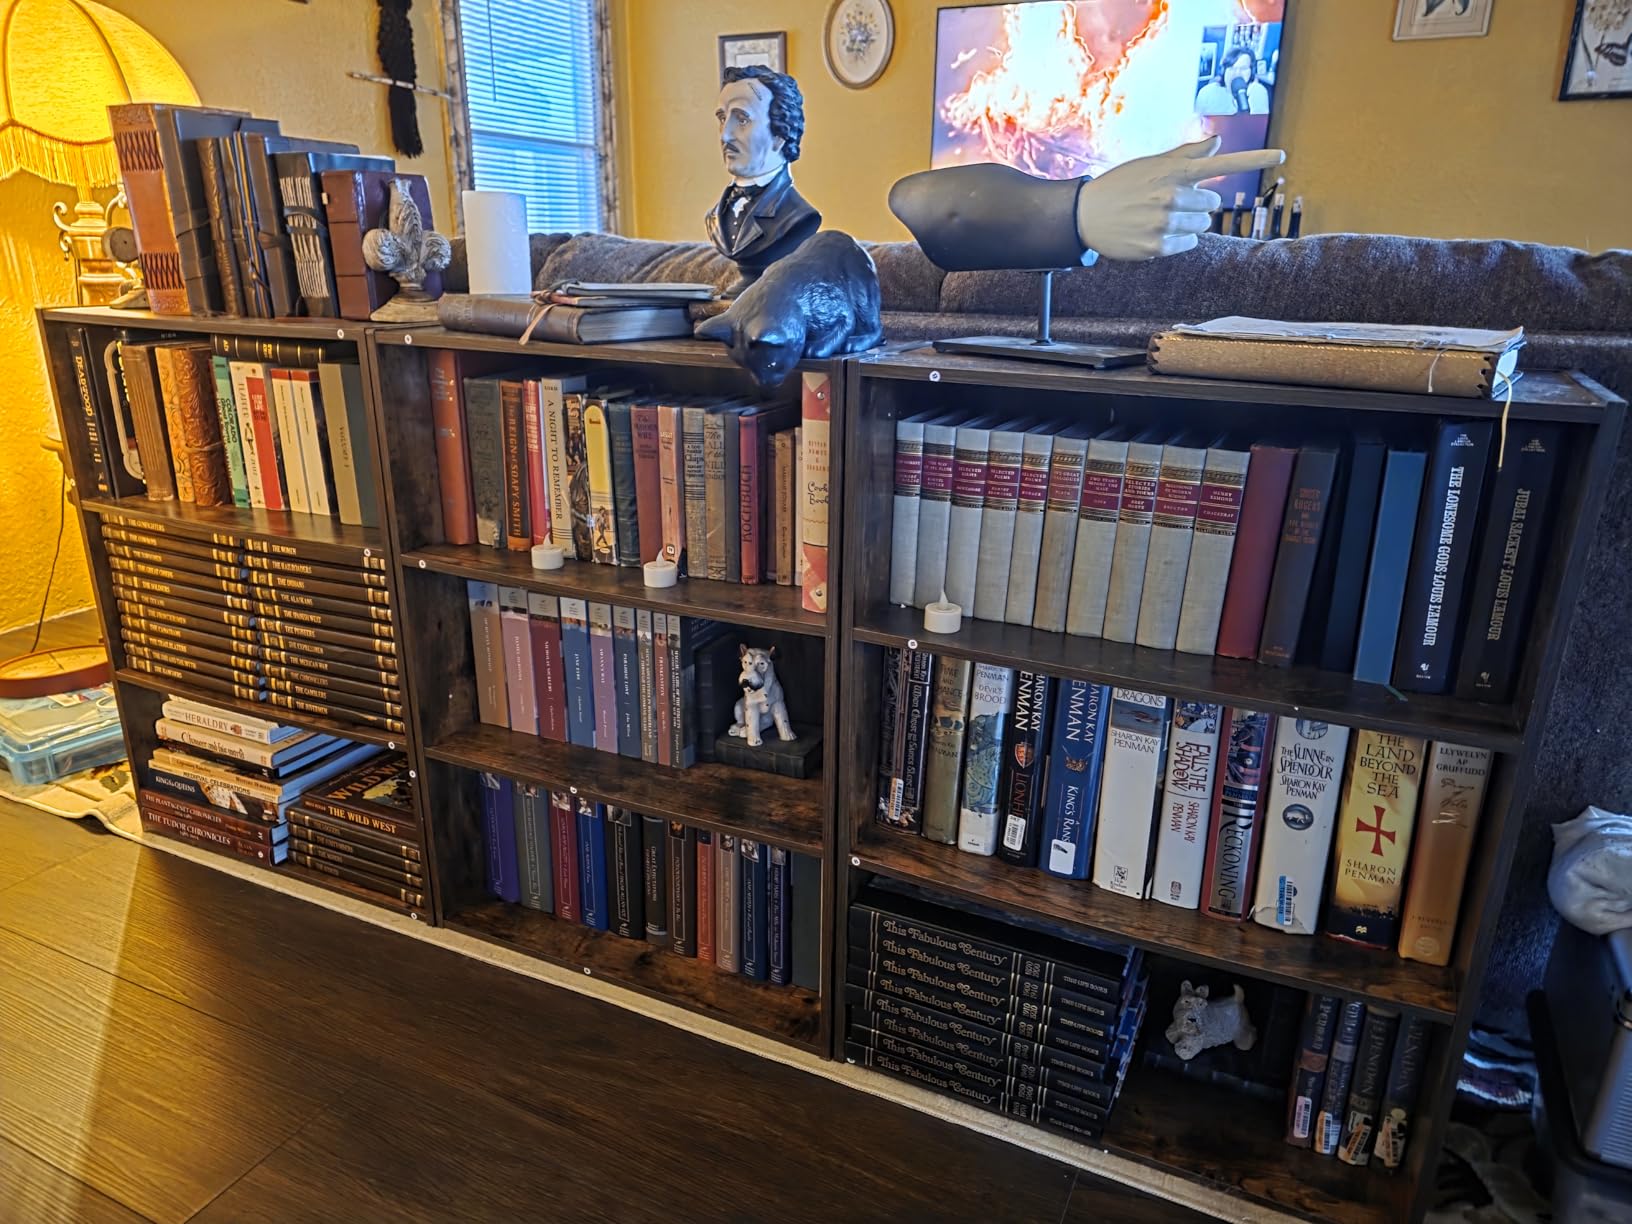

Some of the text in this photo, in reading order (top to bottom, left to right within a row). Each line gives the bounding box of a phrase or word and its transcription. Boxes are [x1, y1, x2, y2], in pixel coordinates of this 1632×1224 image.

[75, 356, 93, 417] DEADWOOD
[225, 398, 237, 443] COLORADO
[508, 418, 518, 452] REIGN
[548, 412, 558, 446] NIGHT
[551, 447, 559, 462] TO
[510, 460, 520, 497] SOAPY
[808, 481, 828, 492] Cook
[1125, 479, 1155, 487] SELECTED
[1448, 466, 1464, 488] THE
[552, 464, 563, 520] REMEMBER
[741, 464, 753, 543] KOCHBUCH
[511, 499, 521, 537] SMITH
[1439, 489, 1461, 545] LONESOME
[1435, 545, 1451, 573] GODS
[1487, 488, 1531, 640] JUBAL SACKETT LOUIS L'AMOUR
[1430, 573, 1447, 604] LOUIS
[1422, 604, 1442, 646] L'AMOUR
[976, 669, 1009, 680] PENMAN
[974, 692, 1007, 704] BROOD
[978, 684, 1004, 695] DEVIL'S
[1014, 670, 1034, 732] ENMAN
[1030, 674, 1046, 732] HARON KAY
[1116, 688, 1164, 707] DRAGONS
[184, 712, 229, 731] HERALDRY
[1065, 679, 1087, 742] ENMAN
[1084, 684, 1100, 744] ARON KAY
[1111, 729, 1160, 746] SHARON KAY
[1113, 738, 1155, 754] PENMAN
[1377, 733, 1405, 748] THE
[1171, 741, 1193, 792] SHADOW
[1281, 745, 1294, 757] THE
[1293, 743, 1326, 765] SUNNE
[1360, 756, 1417, 776] BEYOND
[1365, 743, 1415, 762] LAND
[1439, 747, 1488, 760] LLYWELYN
[1456, 758, 1469, 766] AP
[1188, 773, 1207, 793] THE
[1277, 756, 1333, 781] SPLENDOUR
[1279, 774, 1327, 792] SHARON KAY
[1372, 771, 1399, 786] THE
[155, 775, 170, 786] KINGS
[174, 781, 196, 793] QUEENS
[183, 771, 209, 784] MEDIEVAL
[209, 779, 251, 796] CELEBRATIONS
[1286, 785, 1318, 800] PENMAN
[1366, 782, 1400, 799] SEA
[145, 794, 222, 823] THE PLANTAGENET CHRONICLES
[328, 805, 346, 819] THE
[346, 811, 370, 826] WILD
[371, 818, 397, 834] WEST
[1061, 785, 1079, 842] KING'S RANS
[1170, 802, 1184, 833] PENMAN
[147, 812, 163, 824] THE
[162, 816, 187, 832] TUDOR
[186, 825, 232, 845] CHRONICLES
[1217, 808, 1254, 900] RECKONING
[1346, 858, 1397, 876] SHARON
[1344, 867, 1397, 885] PENMAN
[883, 920, 1008, 966] This Fabulous Century
[883, 940, 1006, 986] This Fabulous Century
[883, 960, 1005, 1007] This Fabulous Century
[1089, 983, 1108, 994] BOOKS
[880, 979, 1002, 1025] This Fabulous Century
[876, 1000, 998, 1046] This Fabulous Century
[883, 1018, 1003, 1067] This Fabulous Century
[882, 1038, 1002, 1087] This Fabulous Century
[877, 1055, 997, 1104] This Fabulous Century
